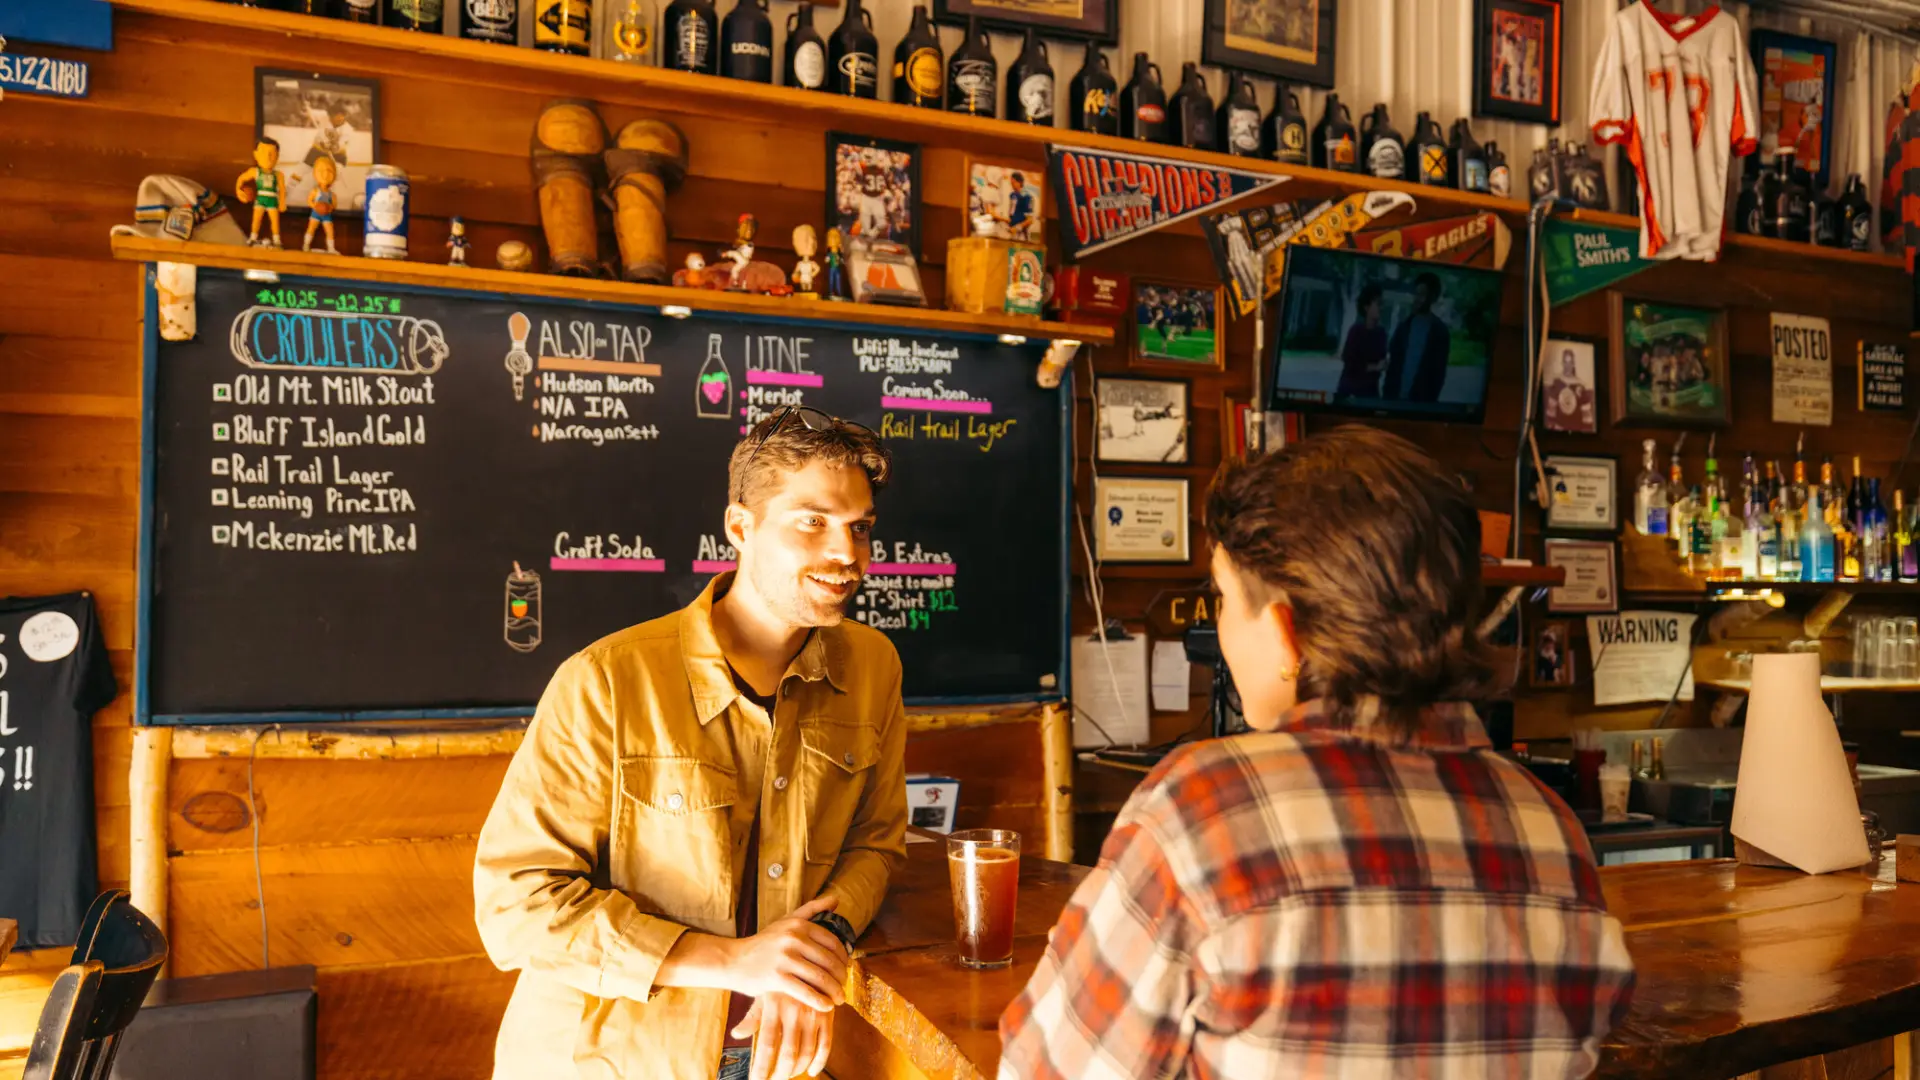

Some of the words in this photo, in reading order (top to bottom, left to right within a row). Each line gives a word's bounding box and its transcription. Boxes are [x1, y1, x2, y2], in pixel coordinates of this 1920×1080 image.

[731, 42, 770, 57] UCONN
[1062, 152, 1216, 245] CHAMPIONS
[1425, 213, 1489, 258] EAGLES
[1574, 232, 1611, 250] PAUL
[253, 312, 399, 369] CROWLERS
[540, 320, 595, 360] ALSO
[606, 323, 652, 363] TAP
[1773, 324, 1829, 361] POSTED
[234, 374, 270, 404] Old
[278, 375, 318, 405] Mt.
[322, 375, 372, 405] Milk
[376, 376, 436, 405] Stout
[542, 372, 603, 393] Hudson
[607, 375, 655, 394] North
[748, 386, 804, 406] Merlot
[882, 375, 933, 400] Coming
[541, 394, 576, 419] N/A
[584, 396, 629, 419] IPA
[300, 415, 375, 447] Island
[377, 414, 426, 445] Gold
[541, 422, 660, 447] Narragansett
[880, 412, 915, 440] Rail
[967, 415, 1017, 452] Lager
[232, 452, 269, 484] Rail
[274, 455, 323, 485] Trail
[333, 455, 394, 493] Lager
[232, 487, 313, 519] Leaning
[325, 487, 372, 513] Pine
[372, 488, 416, 513] IPA
[231, 520, 344, 551] Mckenzie
[349, 523, 383, 555] Mt.
[383, 523, 417, 551] Red
[555, 531, 603, 559] Craft
[608, 534, 655, 559] Soda
[894, 542, 953, 564] Extras
[865, 590, 926, 610] T-Shirt
[929, 590, 959, 611] $12
[868, 610, 907, 629] Decal
[908, 608, 930, 632] $4
[1598, 618, 1678, 644] WARNING
